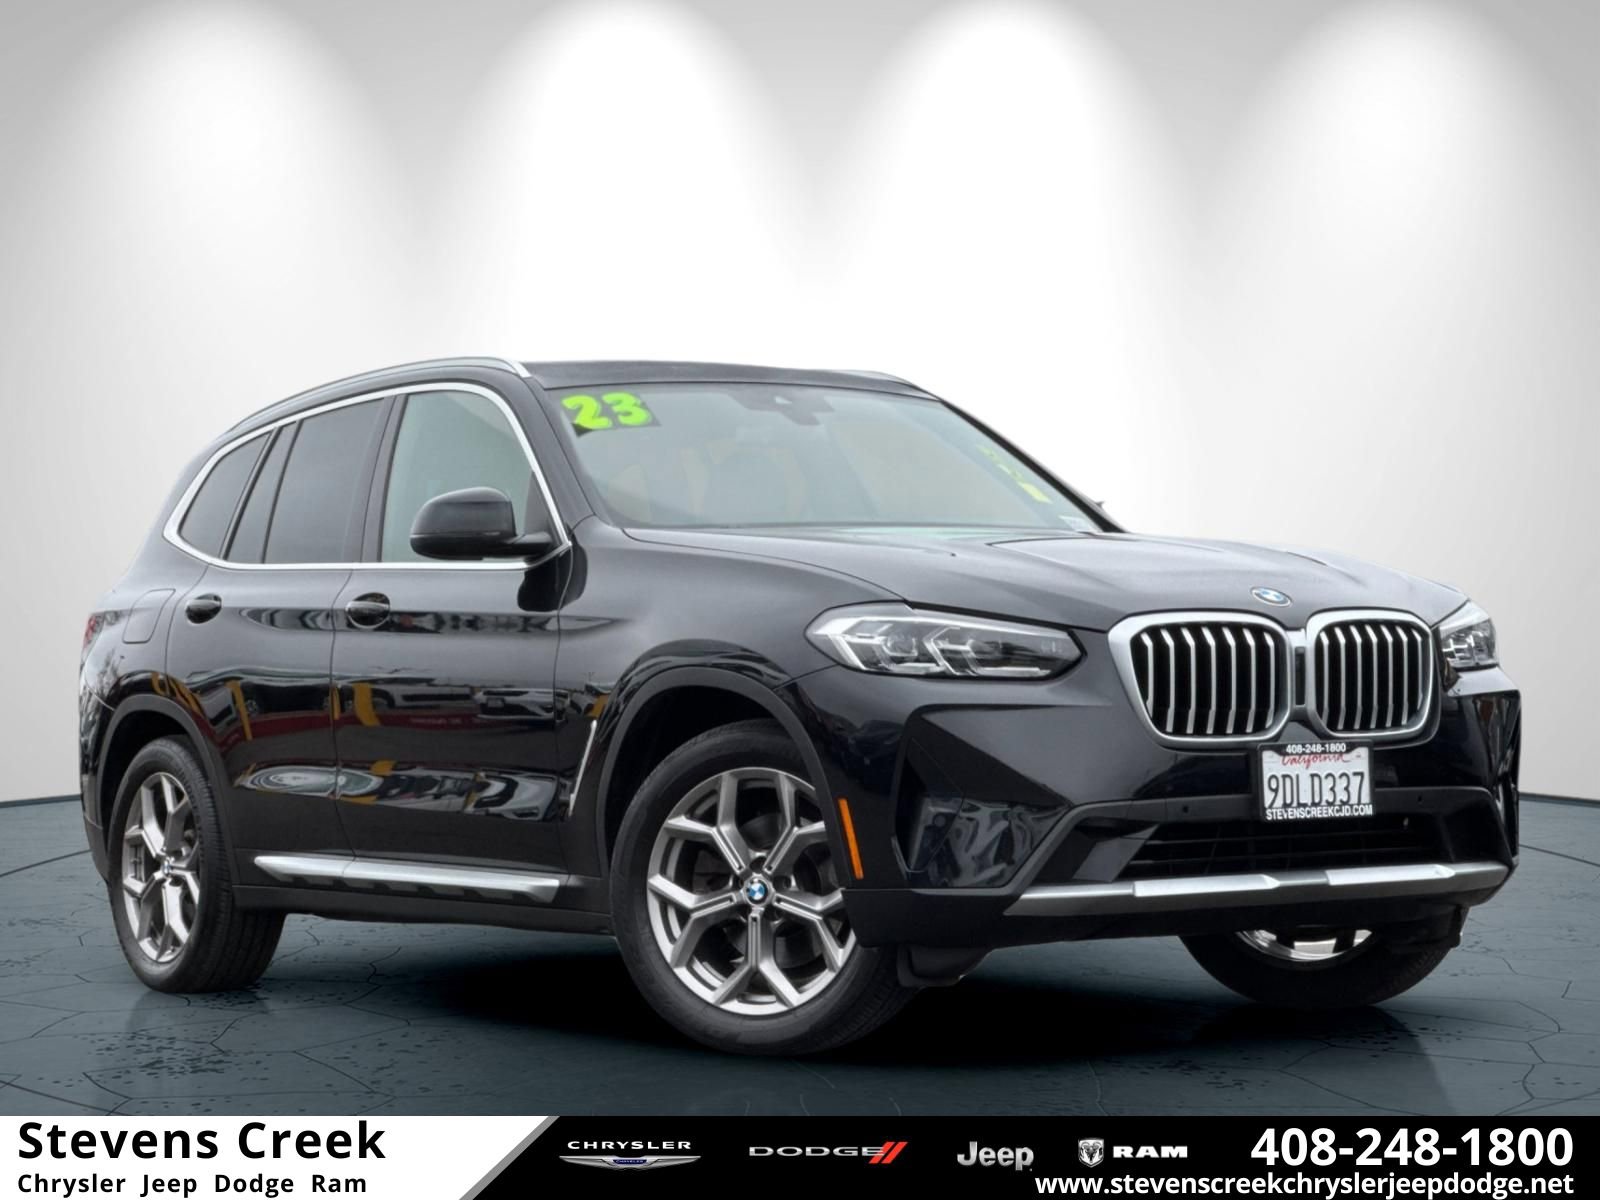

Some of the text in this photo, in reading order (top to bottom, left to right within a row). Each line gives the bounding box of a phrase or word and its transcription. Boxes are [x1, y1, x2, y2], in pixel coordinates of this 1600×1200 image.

[562, 391, 652, 430] 23
[1286, 742, 1346, 754] 408-248-1800
[1267, 771, 1365, 808] 9DLD337
[1265, 804, 1373, 820] STEVENSCREEKCJD.COM
